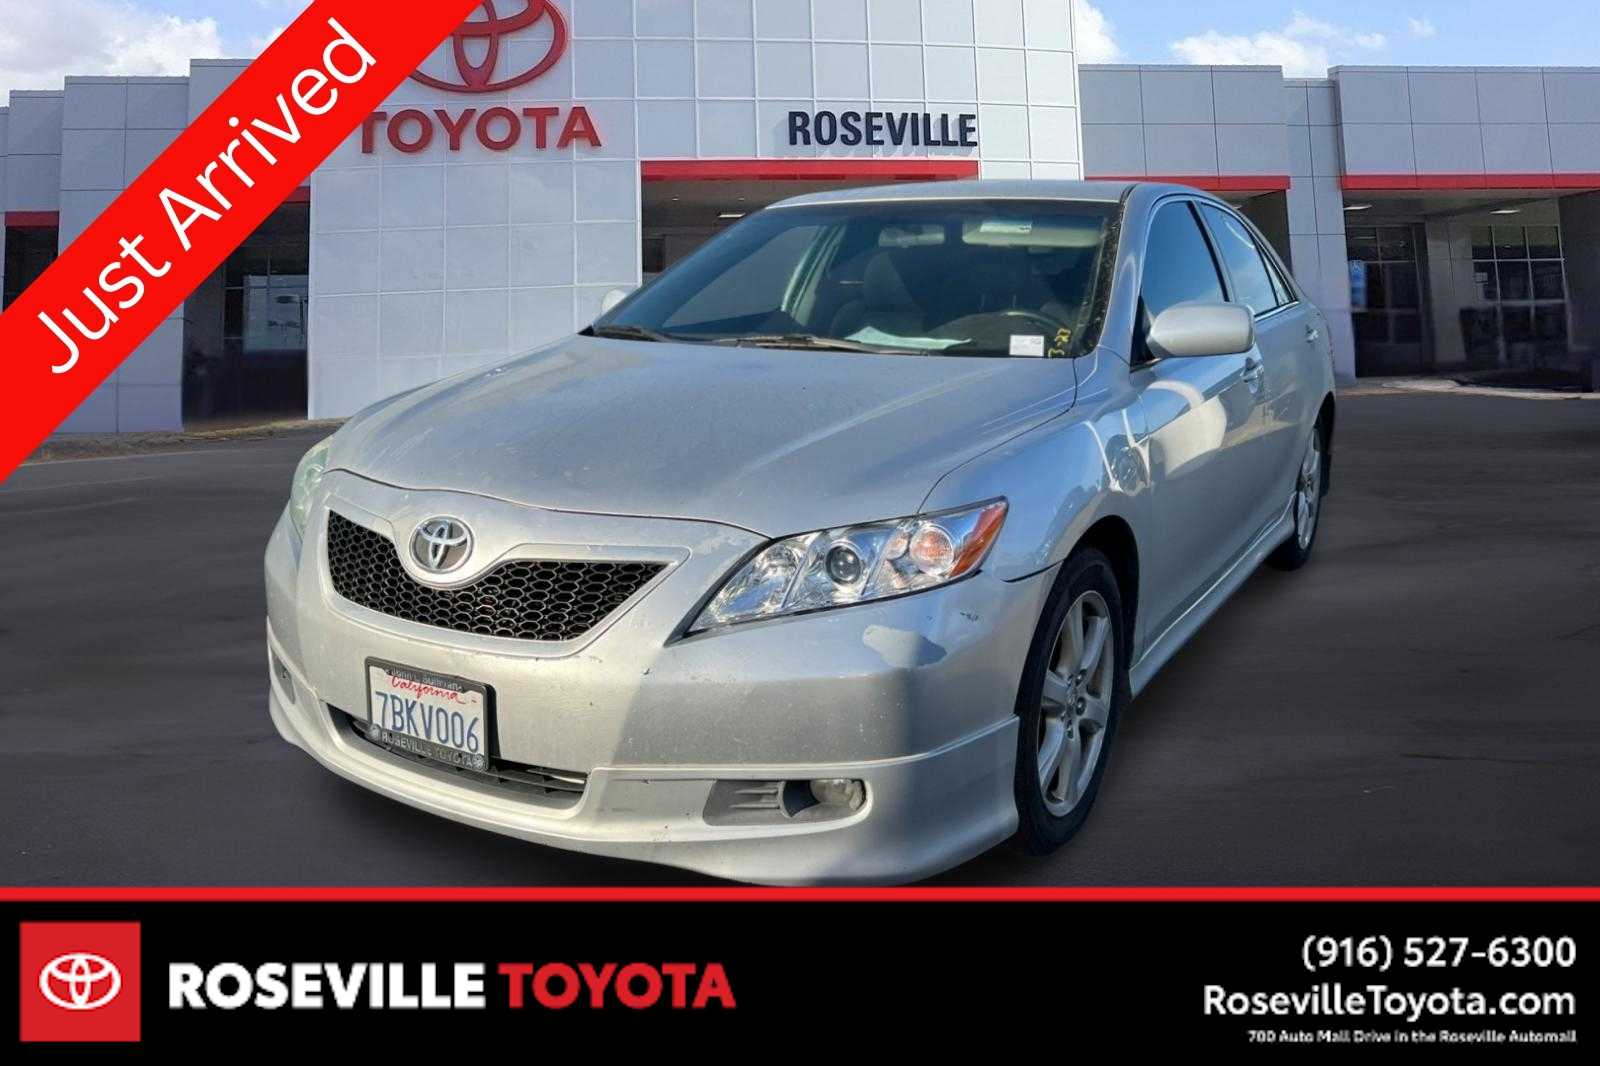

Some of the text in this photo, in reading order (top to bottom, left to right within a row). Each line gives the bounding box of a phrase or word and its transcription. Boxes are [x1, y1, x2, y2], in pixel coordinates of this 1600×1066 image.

[361, 106, 602, 153] TOYOTA
[788, 111, 978, 146] ROSEVILLE
[391, 676, 466, 704] California
[375, 691, 479, 753] 7BKV006
